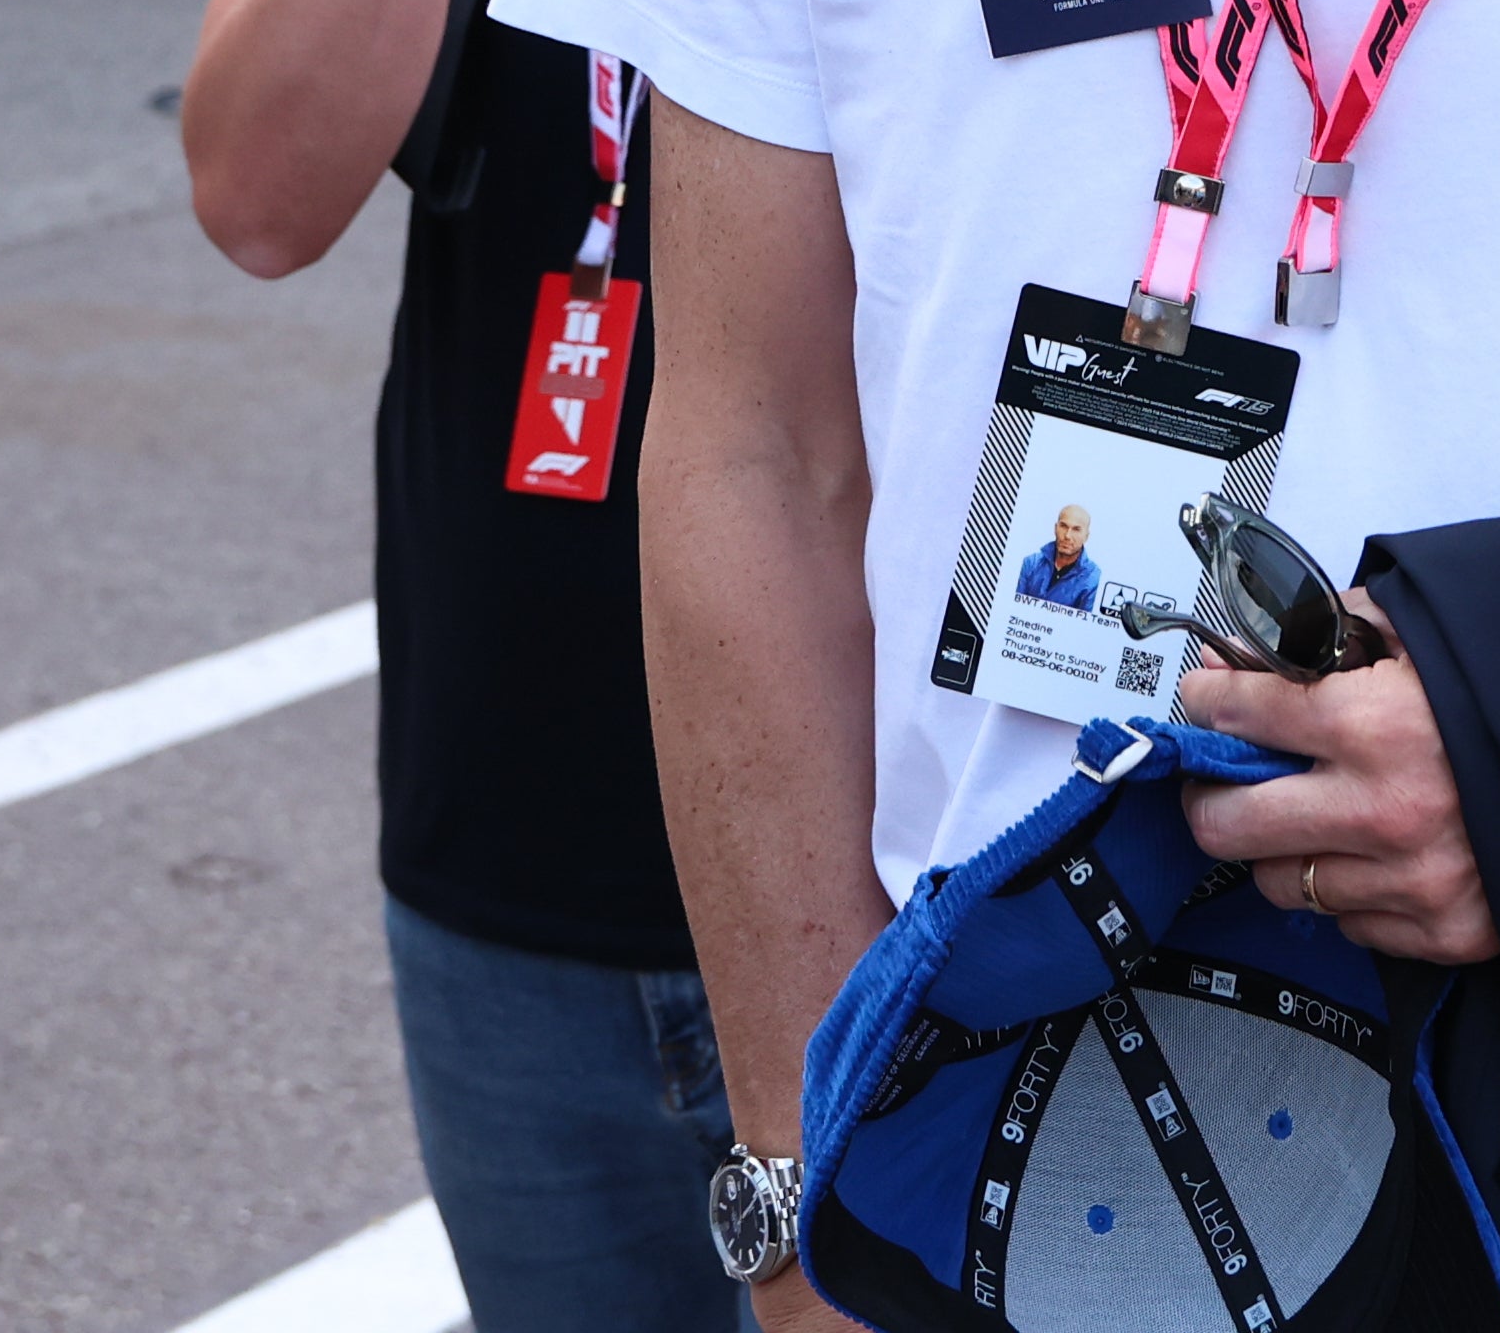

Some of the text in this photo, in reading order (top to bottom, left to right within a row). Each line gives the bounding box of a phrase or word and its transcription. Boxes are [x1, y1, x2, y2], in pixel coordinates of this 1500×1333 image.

[547, 341, 611, 377] PIT
[1023, 333, 1140, 388] VIP Guest
[1007, 615, 1054, 634] Zinedine
[1013, 593, 1121, 629] BWT Alpine F1 Team
[1005, 626, 1042, 643] Zidane
[1002, 637, 1108, 673] Thursday to Sunday
